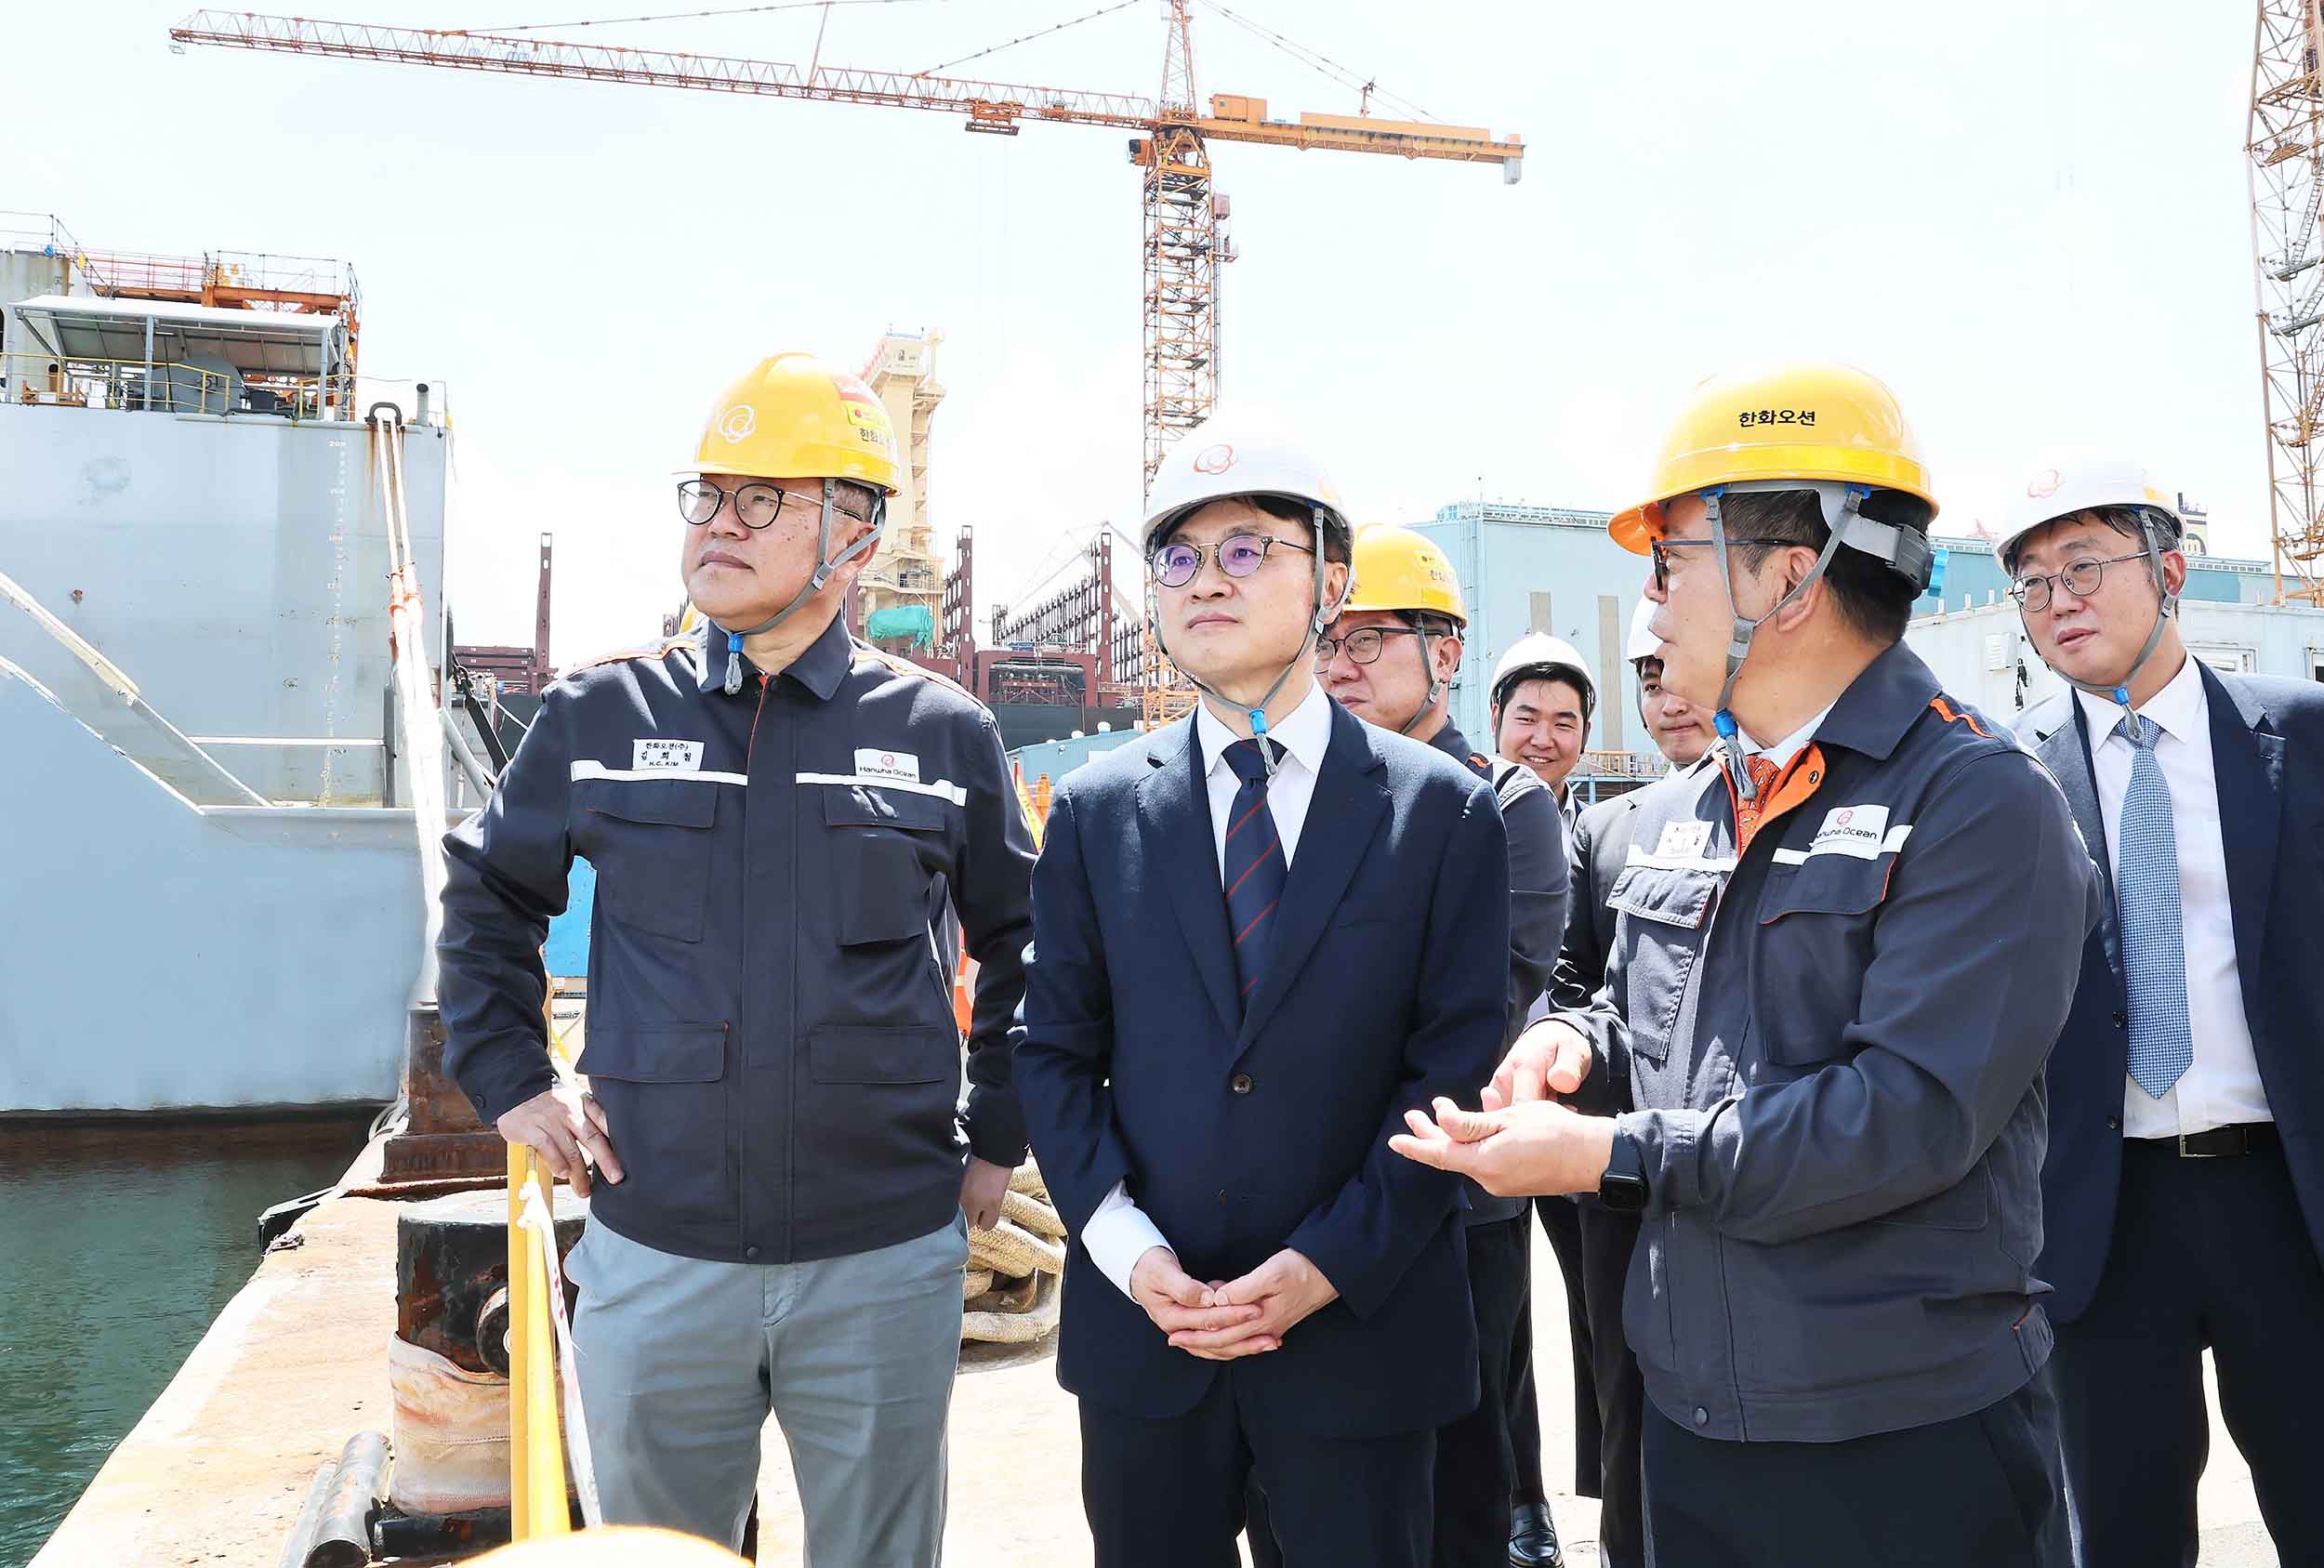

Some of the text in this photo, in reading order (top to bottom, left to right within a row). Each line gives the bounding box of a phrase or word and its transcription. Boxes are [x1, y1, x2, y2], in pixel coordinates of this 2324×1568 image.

[1738, 410, 1816, 428] 한화오션
[859, 766, 917, 778] Hanwha Ocean
[1842, 827, 1877, 839] Ocean
